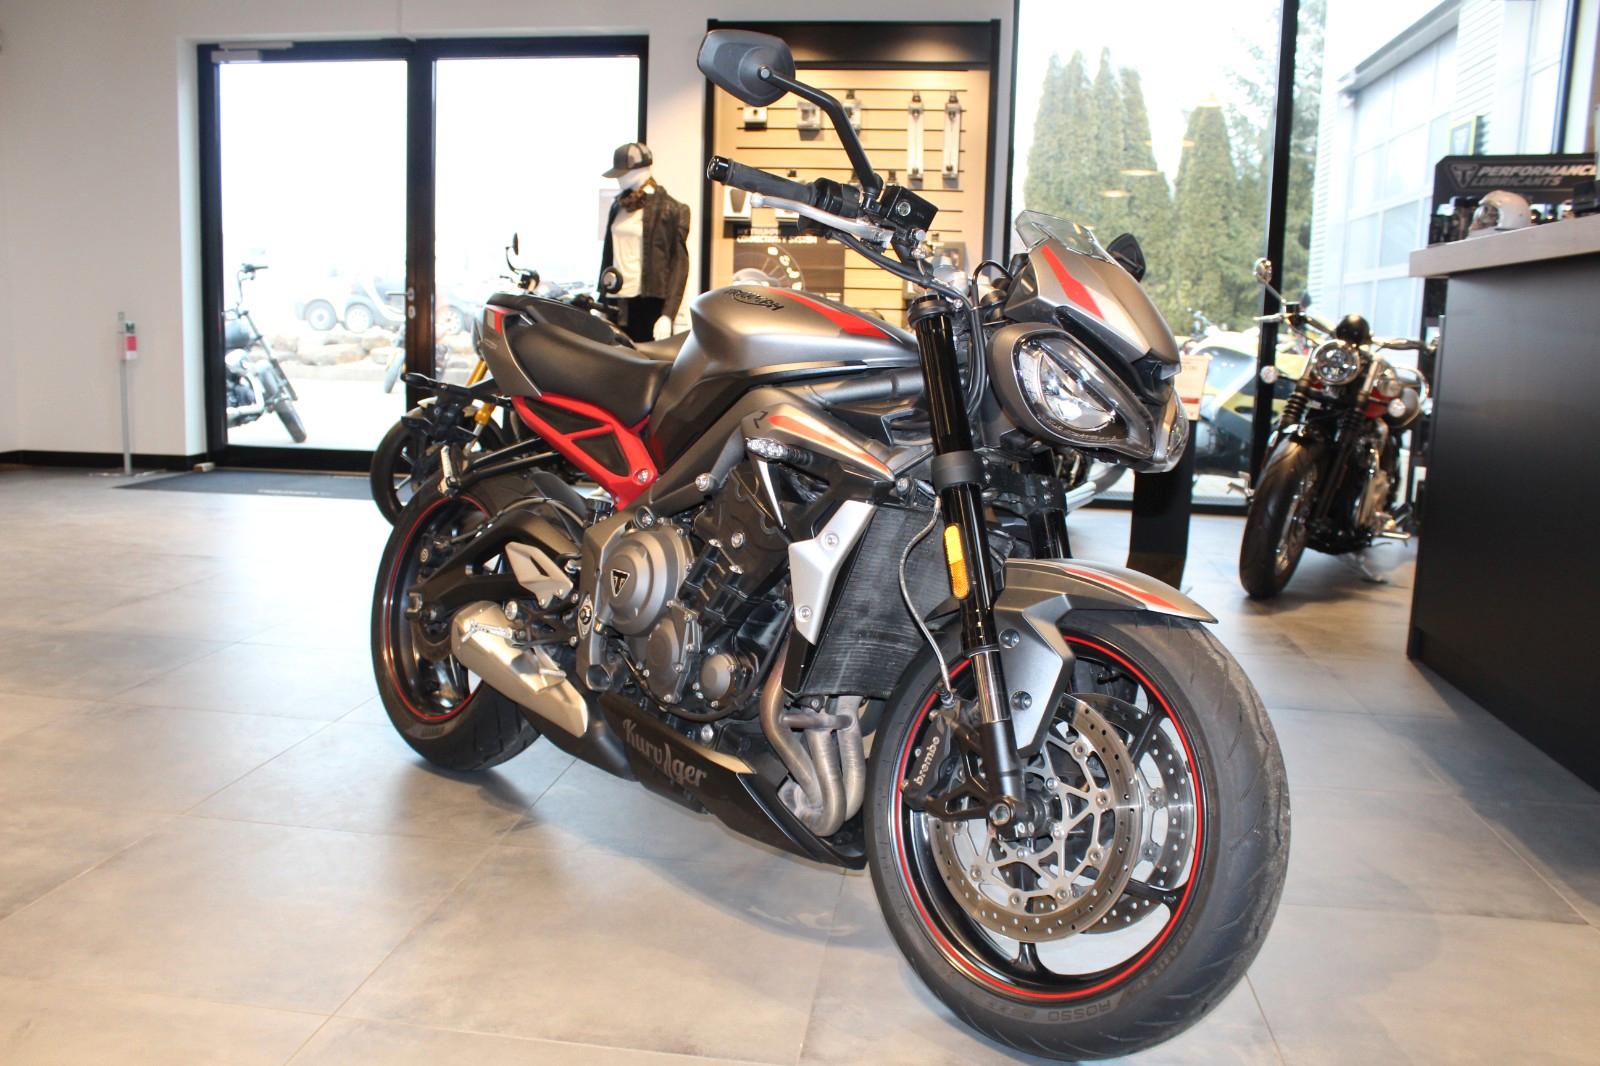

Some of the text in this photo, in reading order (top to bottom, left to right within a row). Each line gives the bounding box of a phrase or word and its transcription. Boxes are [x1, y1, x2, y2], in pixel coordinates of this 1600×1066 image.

[1470, 176, 1563, 187] LUBRICANTS
[914, 736, 940, 786] brembo
[1047, 1000, 1112, 1022] ROSSO
